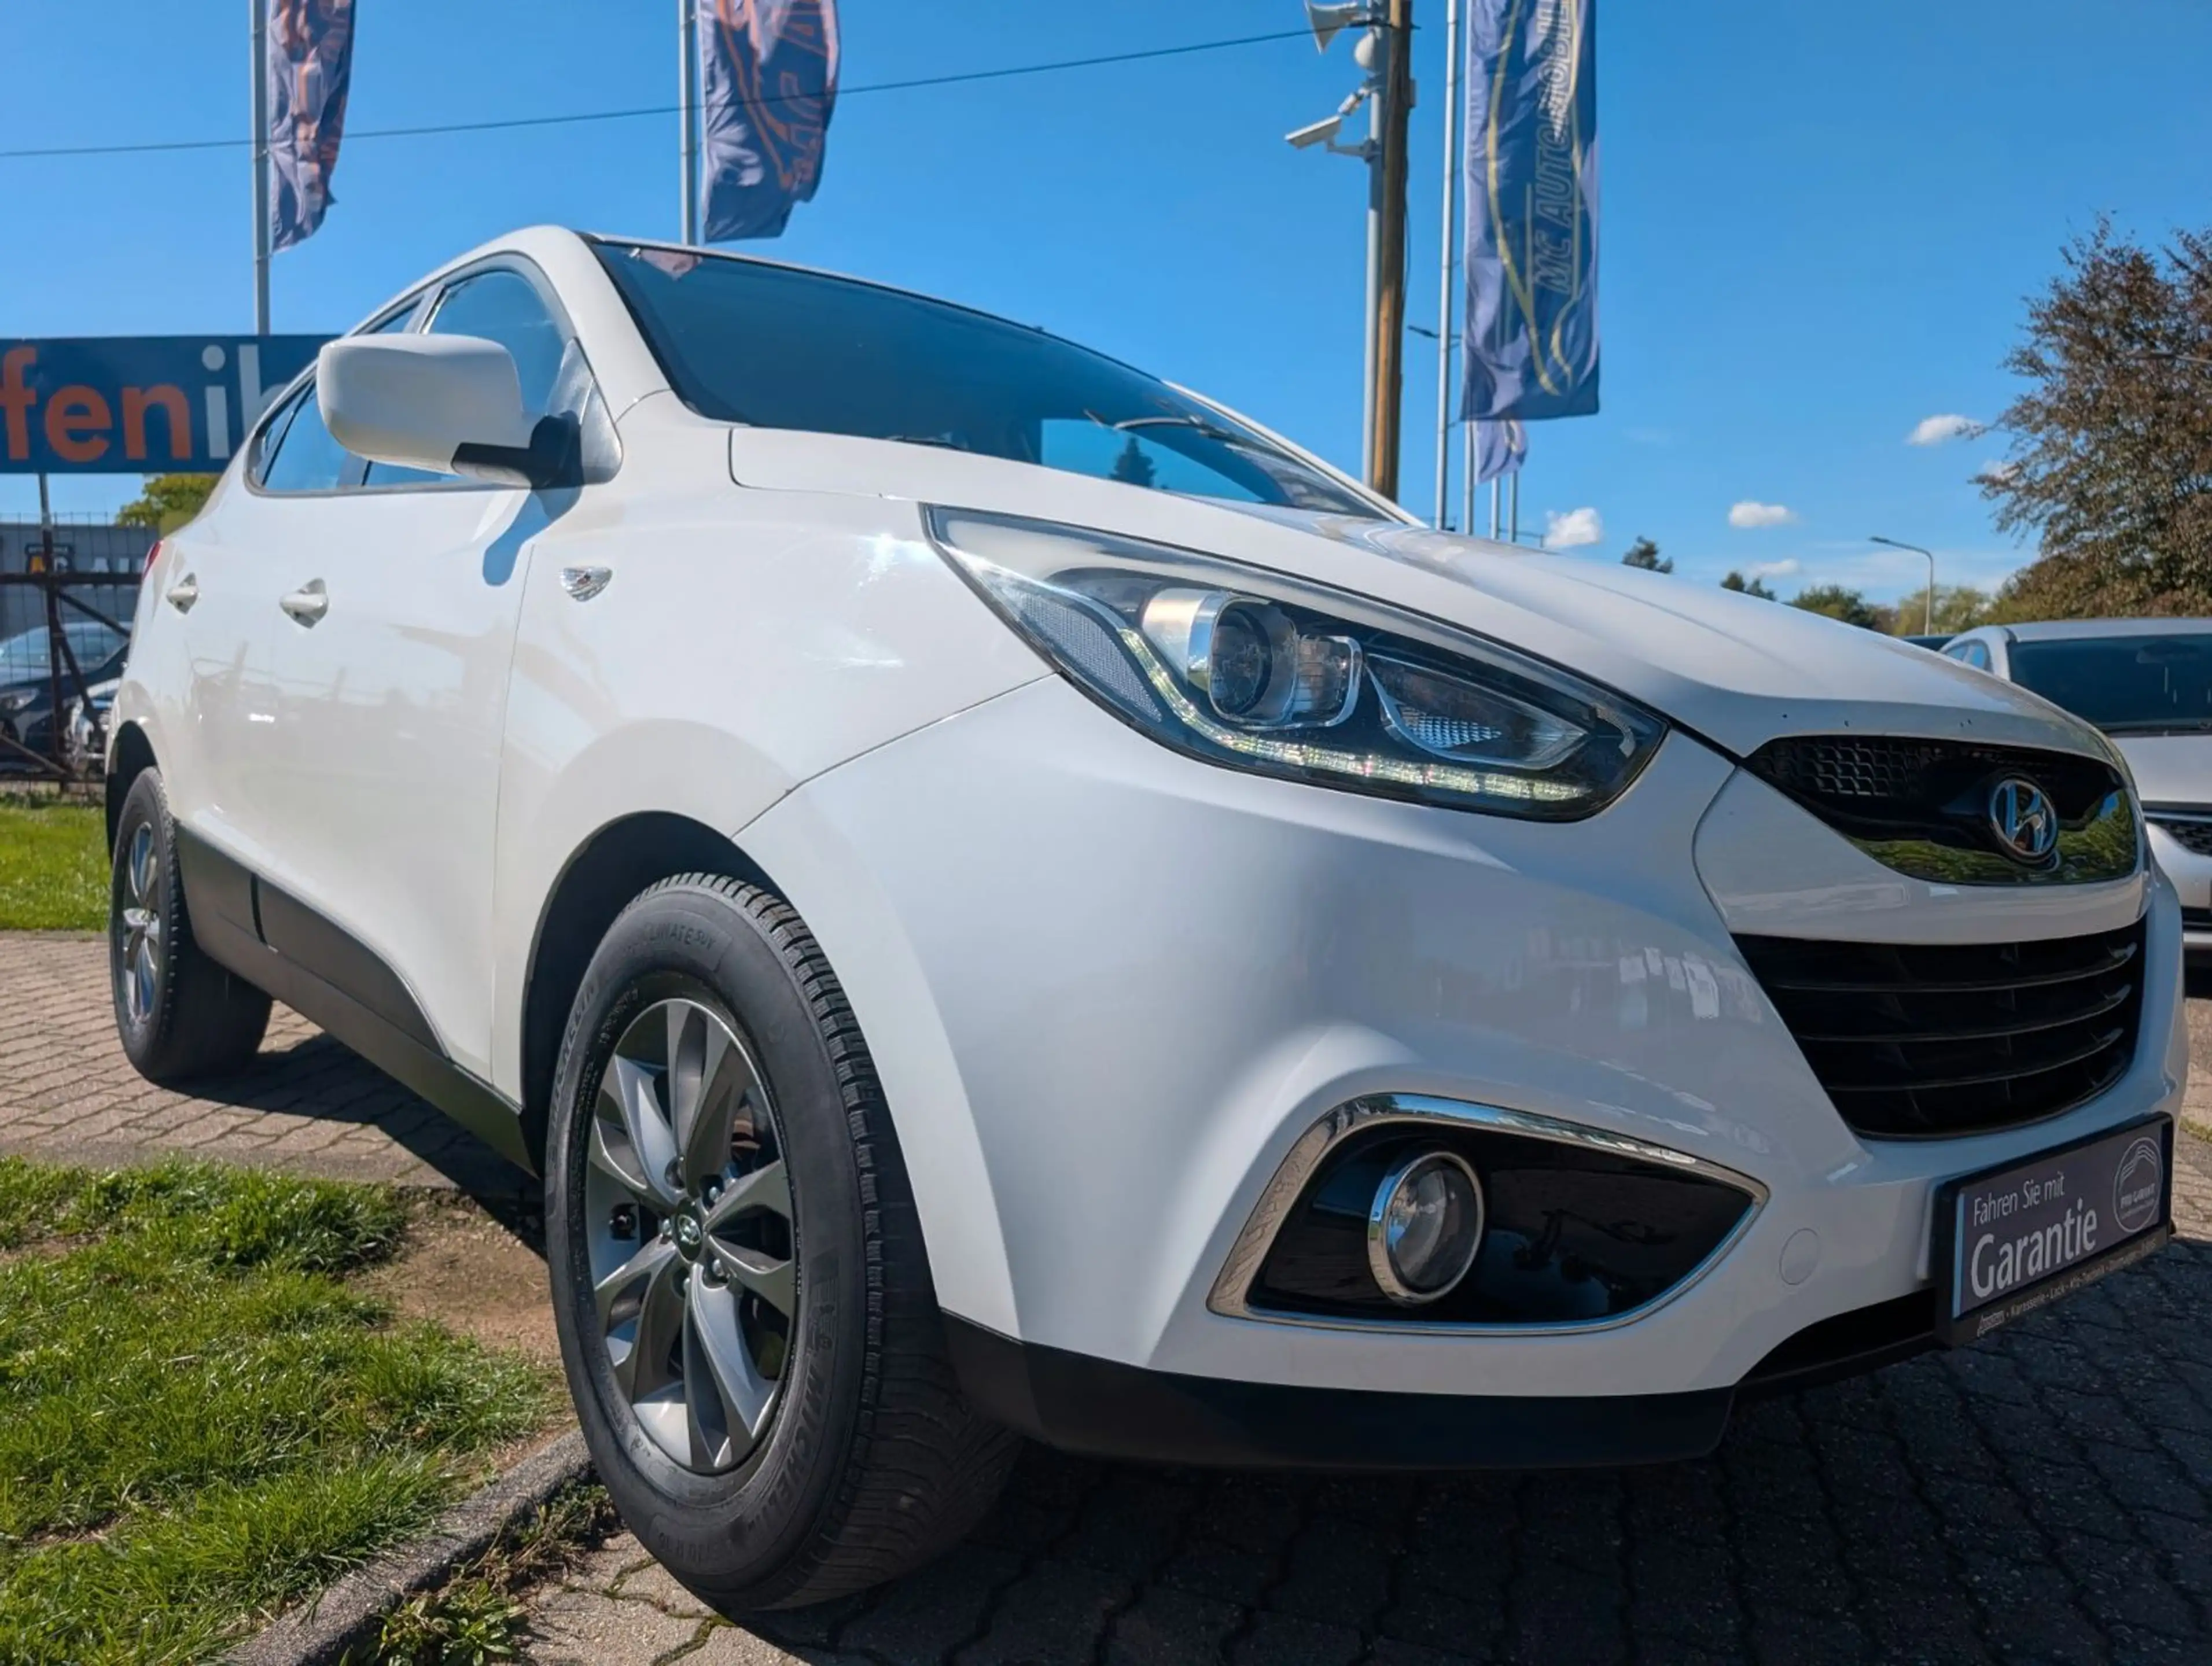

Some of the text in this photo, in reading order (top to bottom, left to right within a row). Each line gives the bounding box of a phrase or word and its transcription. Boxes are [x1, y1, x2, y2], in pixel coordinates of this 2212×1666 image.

[1534, 229, 1573, 294] MC
[1974, 1171, 2066, 1226] Fahren Sie mit
[1970, 1197, 2098, 1299] Garantie
